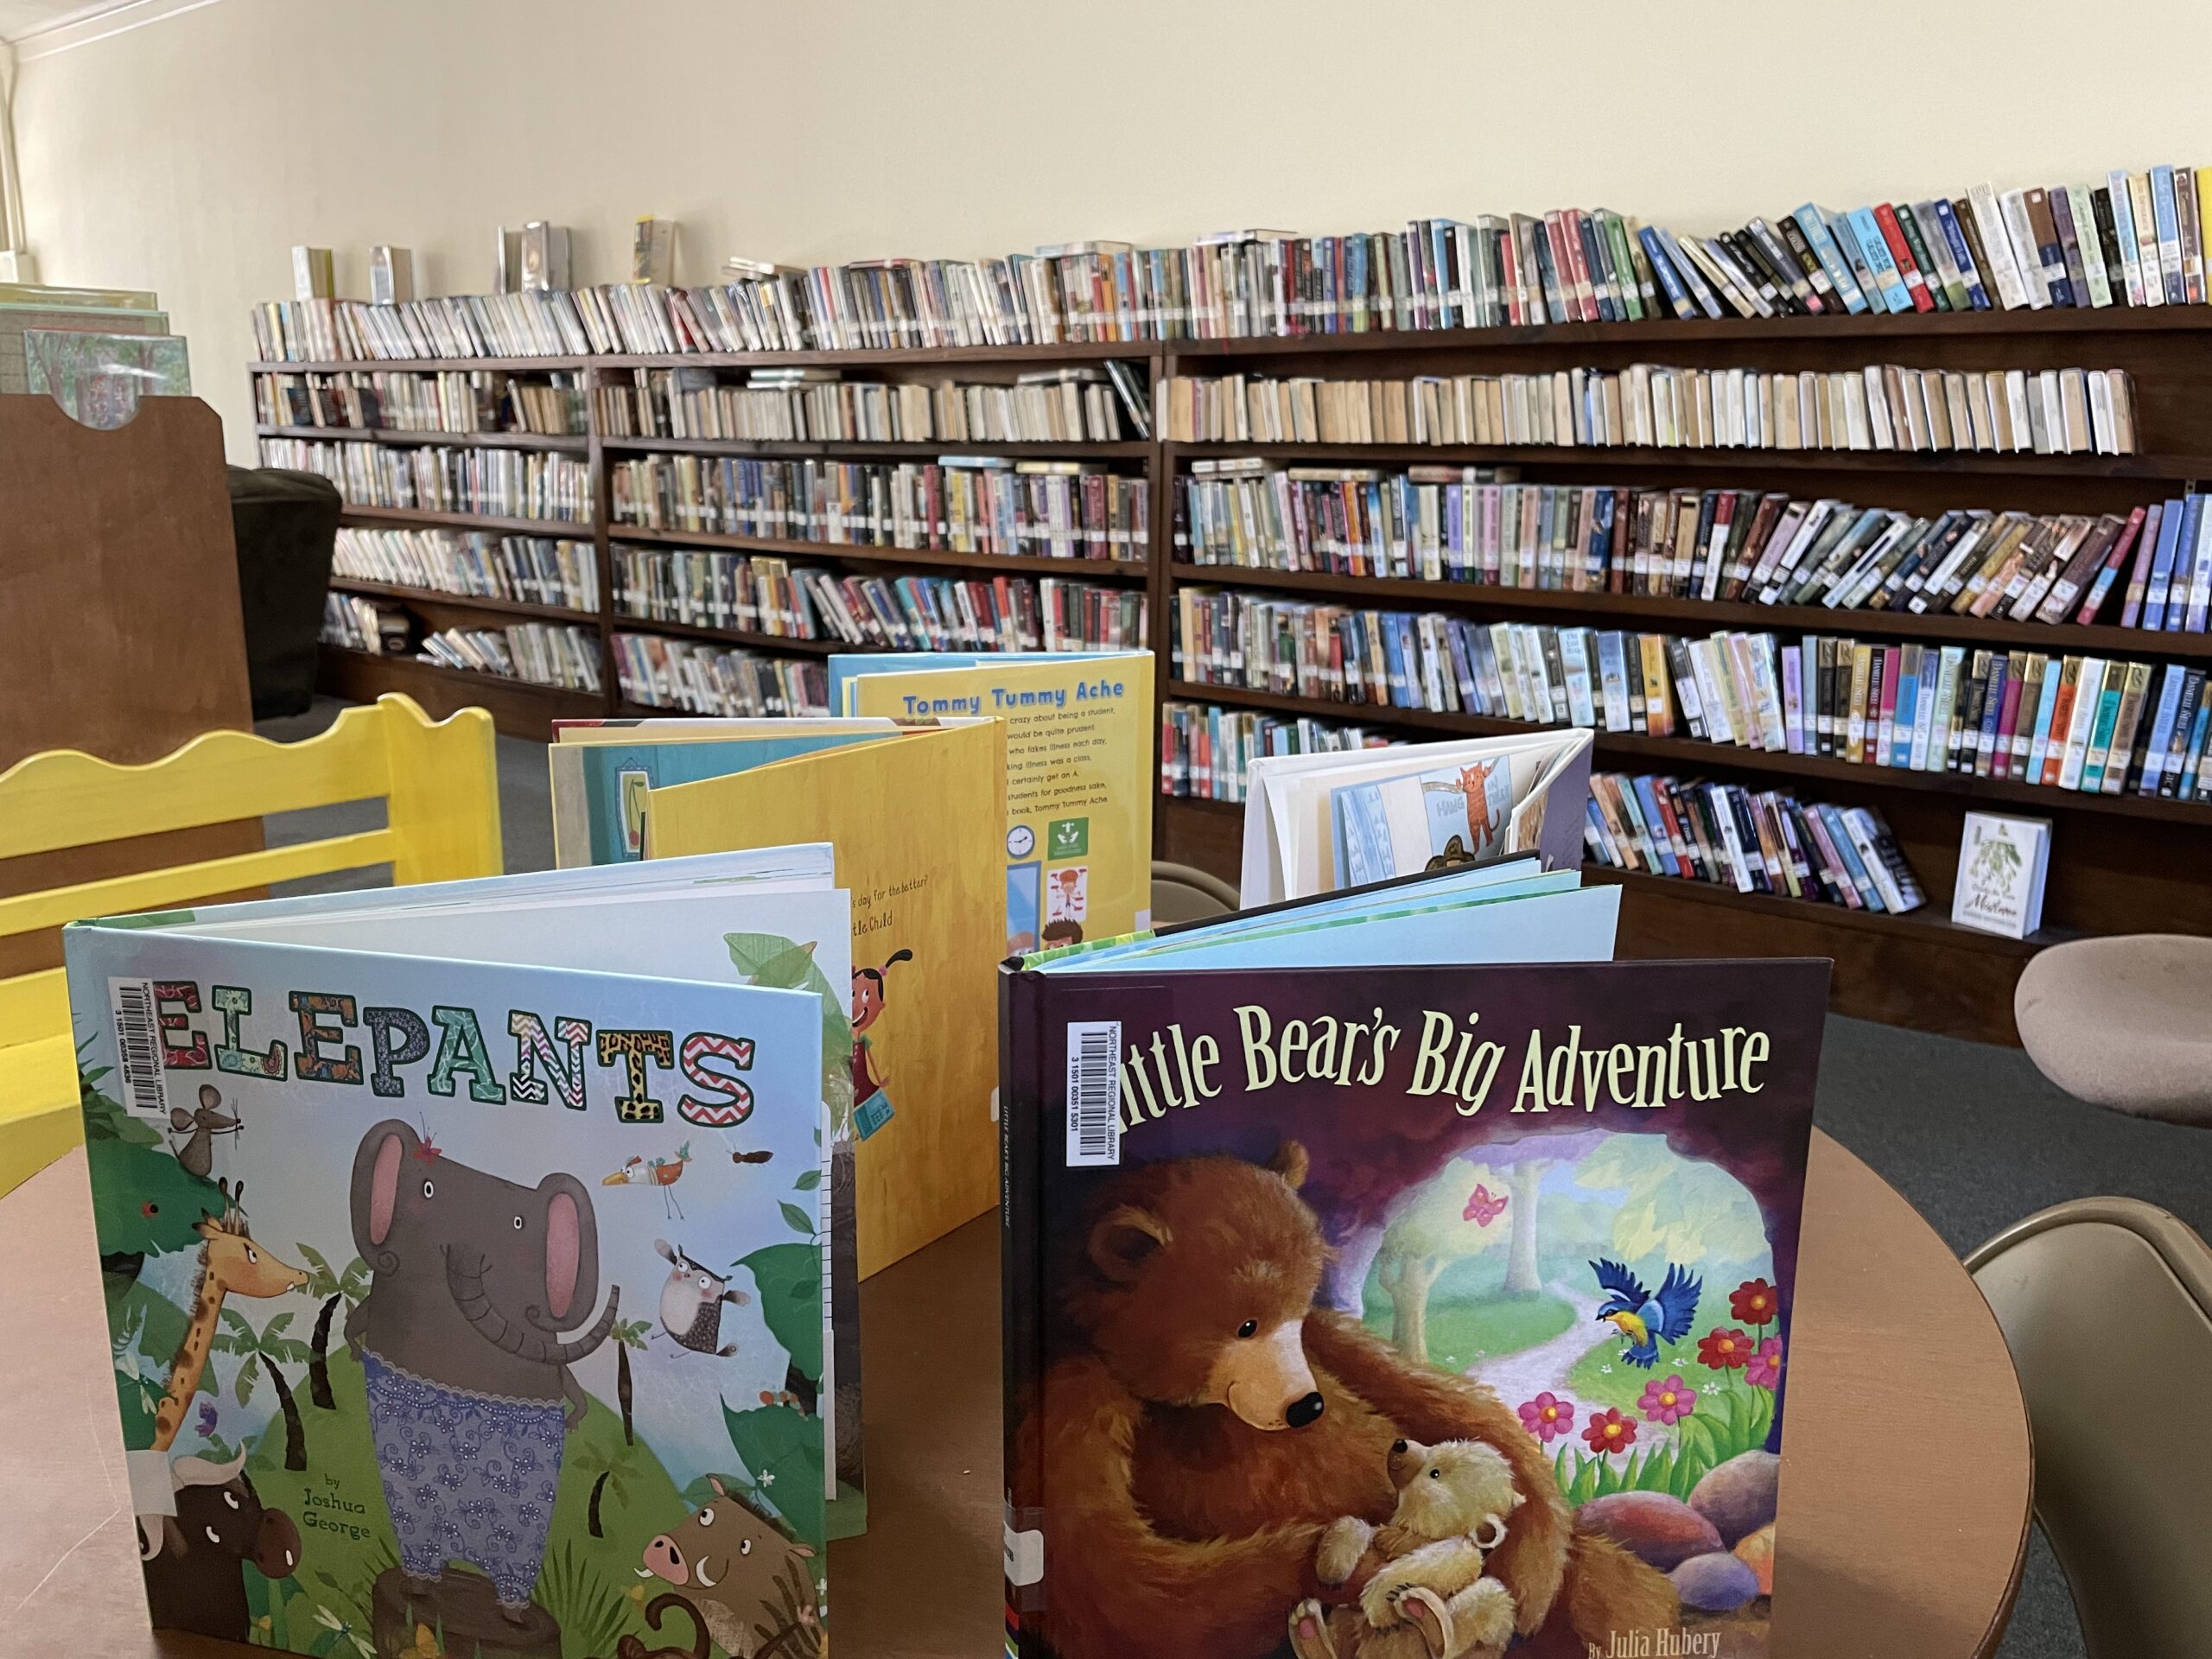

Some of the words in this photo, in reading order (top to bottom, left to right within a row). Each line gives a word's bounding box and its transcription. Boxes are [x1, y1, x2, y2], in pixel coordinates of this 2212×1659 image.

[903, 695, 981, 715] Tommy
[991, 688, 1067, 708] Tummy
[1076, 679, 1124, 702] Ache
[1009, 715, 1030, 724] crazy
[1033, 714, 1056, 722] about
[1058, 711, 1078, 720] being
[1007, 731, 1031, 740] would
[1033, 729, 1043, 738] be
[1046, 728, 1065, 738] quite
[1008, 747, 1025, 755] who
[1027, 744, 1047, 753] fakes
[1049, 742, 1071, 751] illness
[1072, 740, 1090, 748] each
[1007, 762, 1023, 772] king
[1026, 760, 1047, 769] illness
[1012, 775, 1045, 785] certainly
[1046, 773, 1059, 783] get
[1007, 791, 1039, 801] students
[1054, 785, 1086, 797] goodness
[1034, 802, 1060, 812] Tommy
[1062, 798, 1087, 809] Tummy
[858, 893, 872, 909] day
[874, 889, 886, 901] for
[889, 885, 900, 897] the
[901, 874, 929, 893] better?
[852, 920, 868, 937] tle
[869, 909, 893, 931] Child
[142, 982, 156, 1033] NORTHEAST
[116, 1018, 124, 1036] 1501
[149, 1035, 162, 1077] REGIONAL
[152, 980, 755, 1128] ELEPANTS
[1107, 1026, 1117, 1077] NORTHEAST
[1118, 1026, 1223, 1135] ittle
[1232, 1005, 1402, 1092] Bear's
[1406, 1010, 1506, 1116] Big
[1510, 1022, 1770, 1113] Adventure
[155, 1079, 167, 1115] LIBRARY
[1107, 1080, 1116, 1122] REGIONAL
[1107, 1125, 1116, 1160] LIBRARY
[324, 1472, 340, 1490] by
[304, 1488, 365, 1515] Joshua
[302, 1511, 371, 1541] George
[1588, 1642, 1601, 1659] By
[1605, 1630, 1650, 1659] Julia
[1655, 1627, 1722, 1658] Hubery
